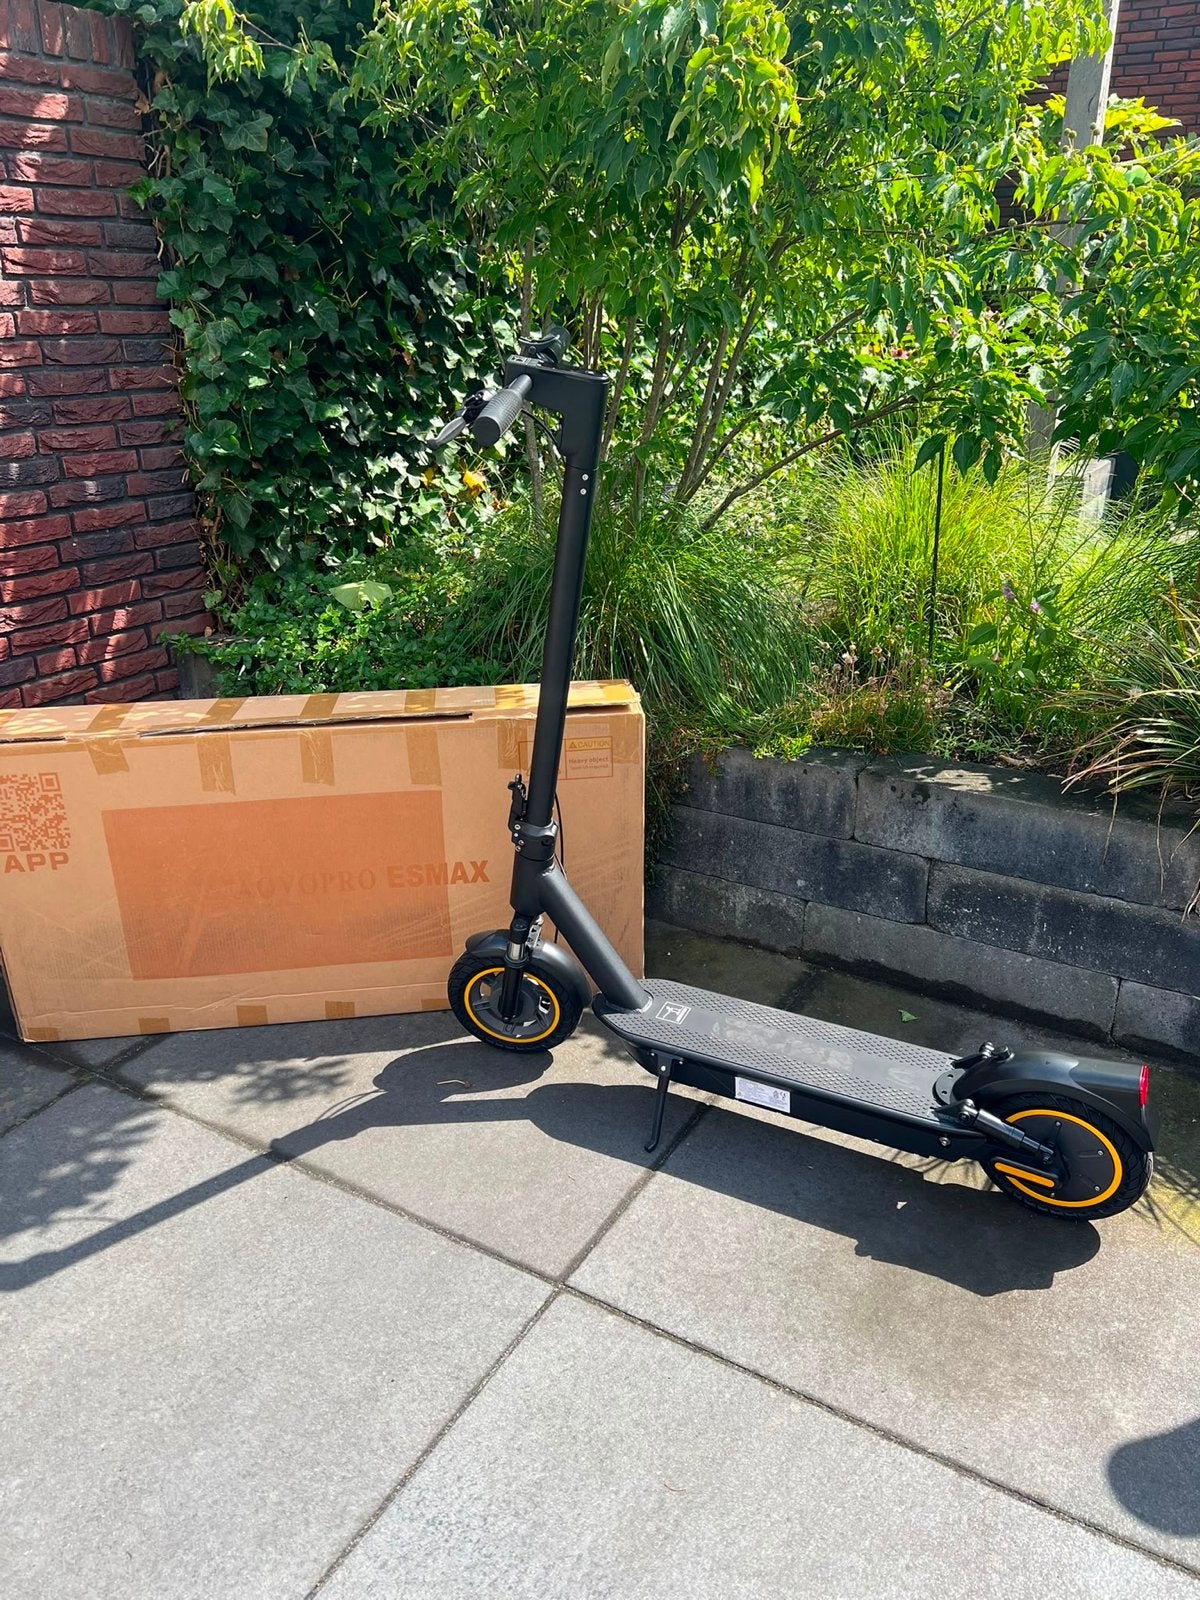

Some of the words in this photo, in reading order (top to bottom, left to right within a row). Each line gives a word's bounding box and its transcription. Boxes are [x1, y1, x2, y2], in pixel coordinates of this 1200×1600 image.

[577, 740, 610, 748] CAUTION
[589, 756, 609, 764] object
[4, 852, 69, 873] APP
[386, 860, 490, 888] ESMAX
